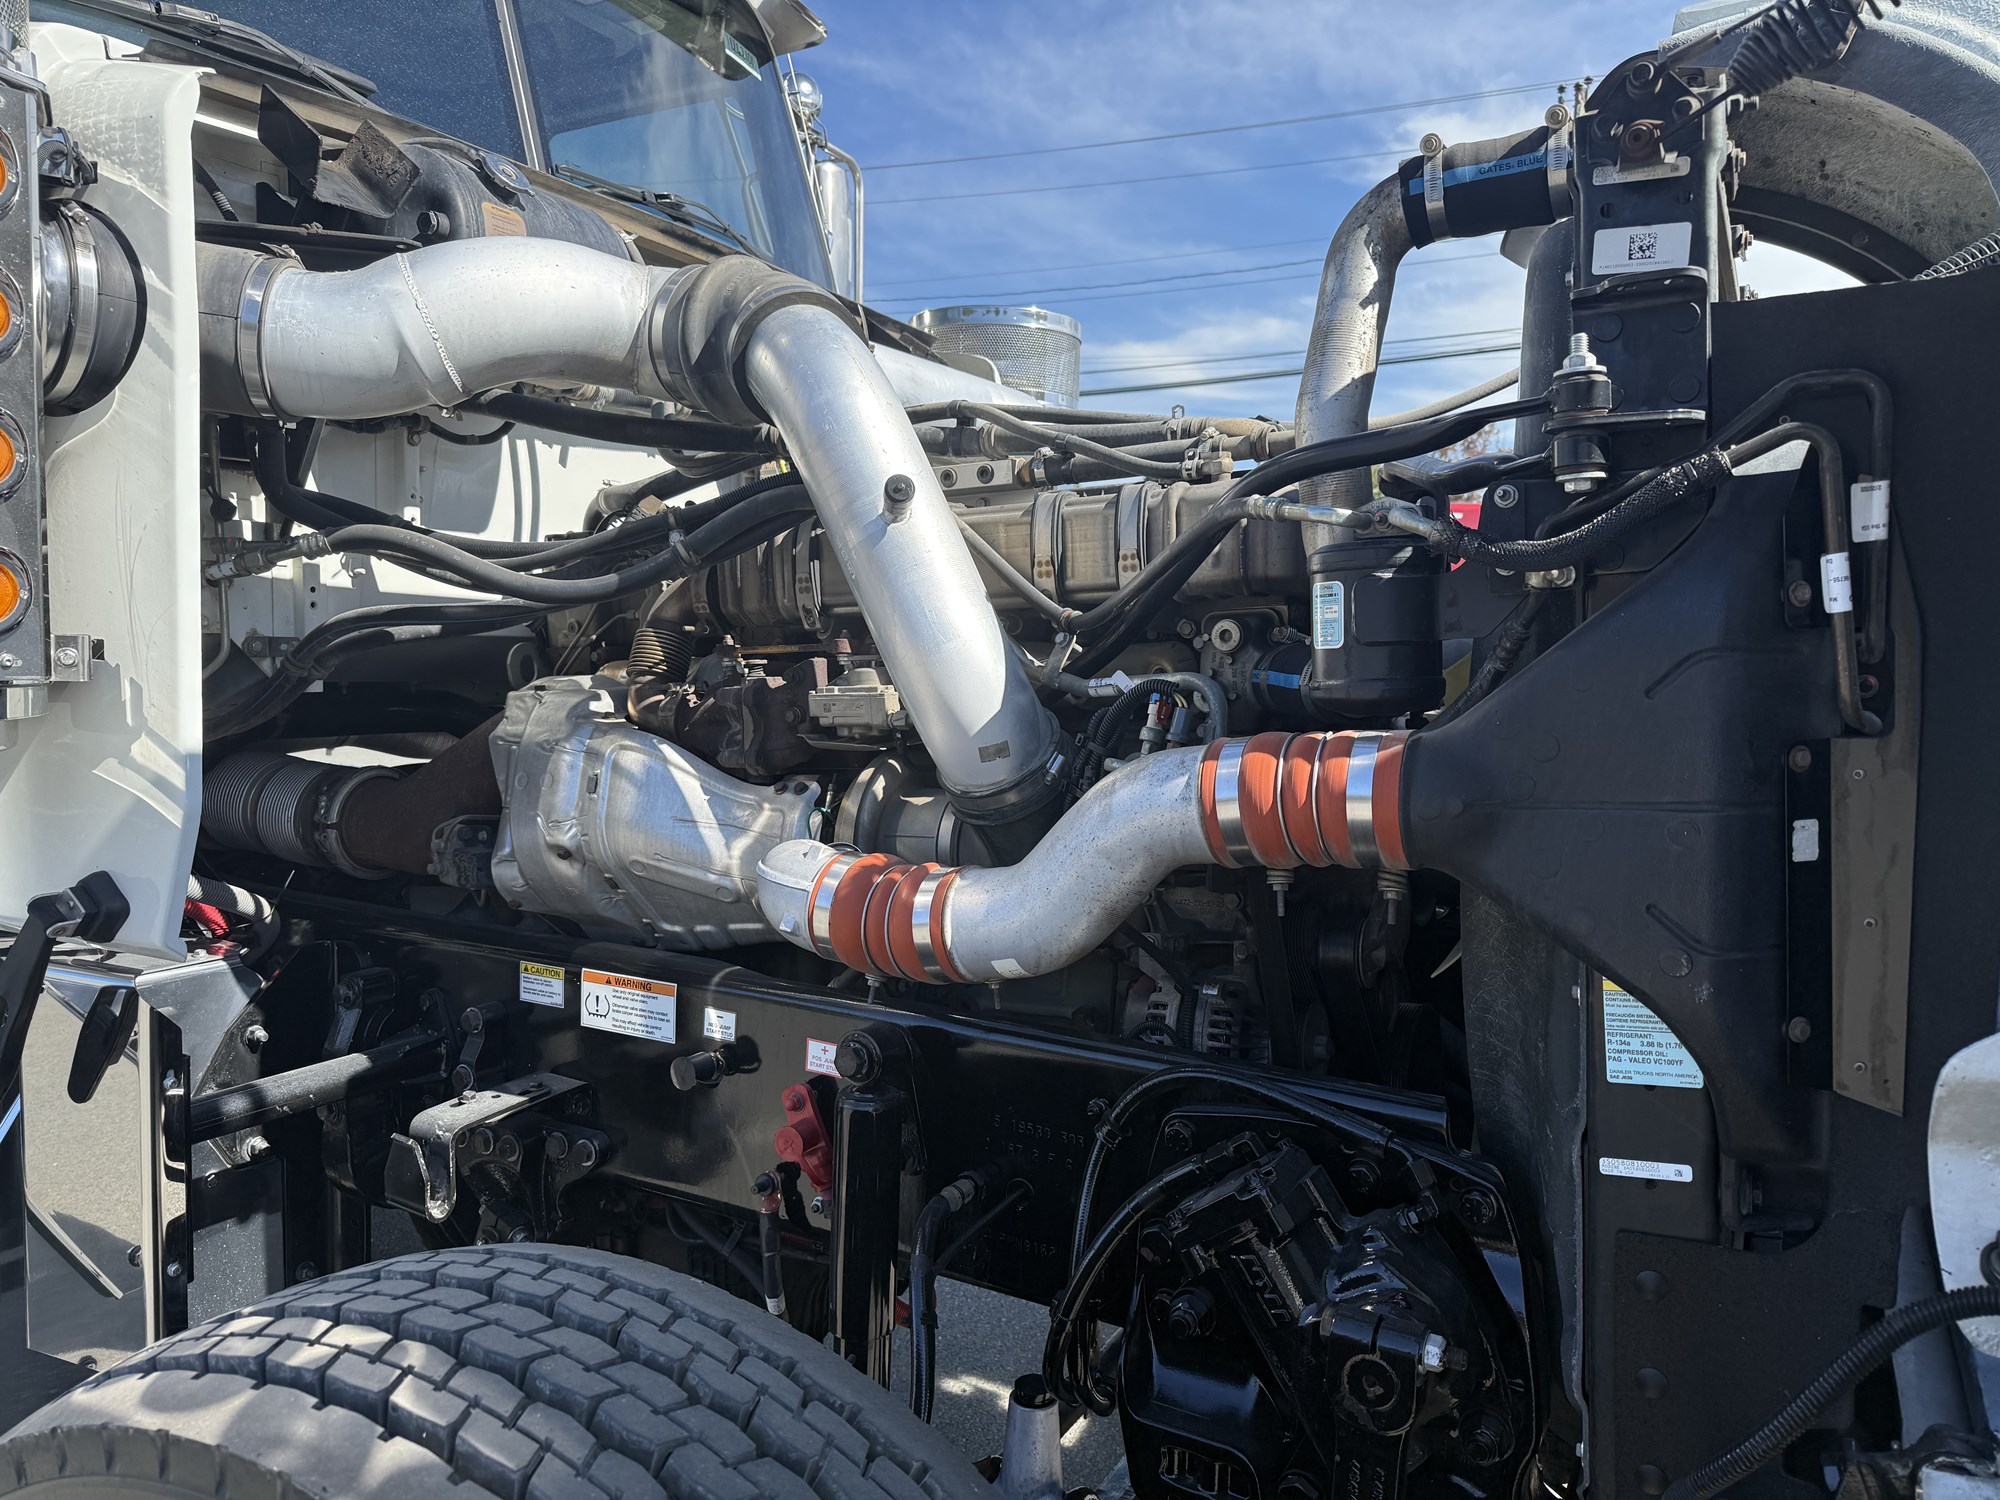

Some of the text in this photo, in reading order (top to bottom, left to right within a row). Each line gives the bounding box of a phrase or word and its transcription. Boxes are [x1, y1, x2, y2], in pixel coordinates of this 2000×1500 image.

[1516, 155, 1544, 168] BLUE
[530, 966, 561, 978] CAUTION
[614, 977, 652, 992] WARNING
[719, 1023, 732, 1031] JUMP
[721, 1030, 734, 1038] STUD
[1607, 1031, 1654, 1040] REFRIGERANT:
[1607, 1039, 1631, 1047] R-134a
[1640, 1040, 1655, 1048] 3.88
[1607, 1048, 1653, 1057] COMPRESSOR
[810, 1061, 837, 1072] START STU
